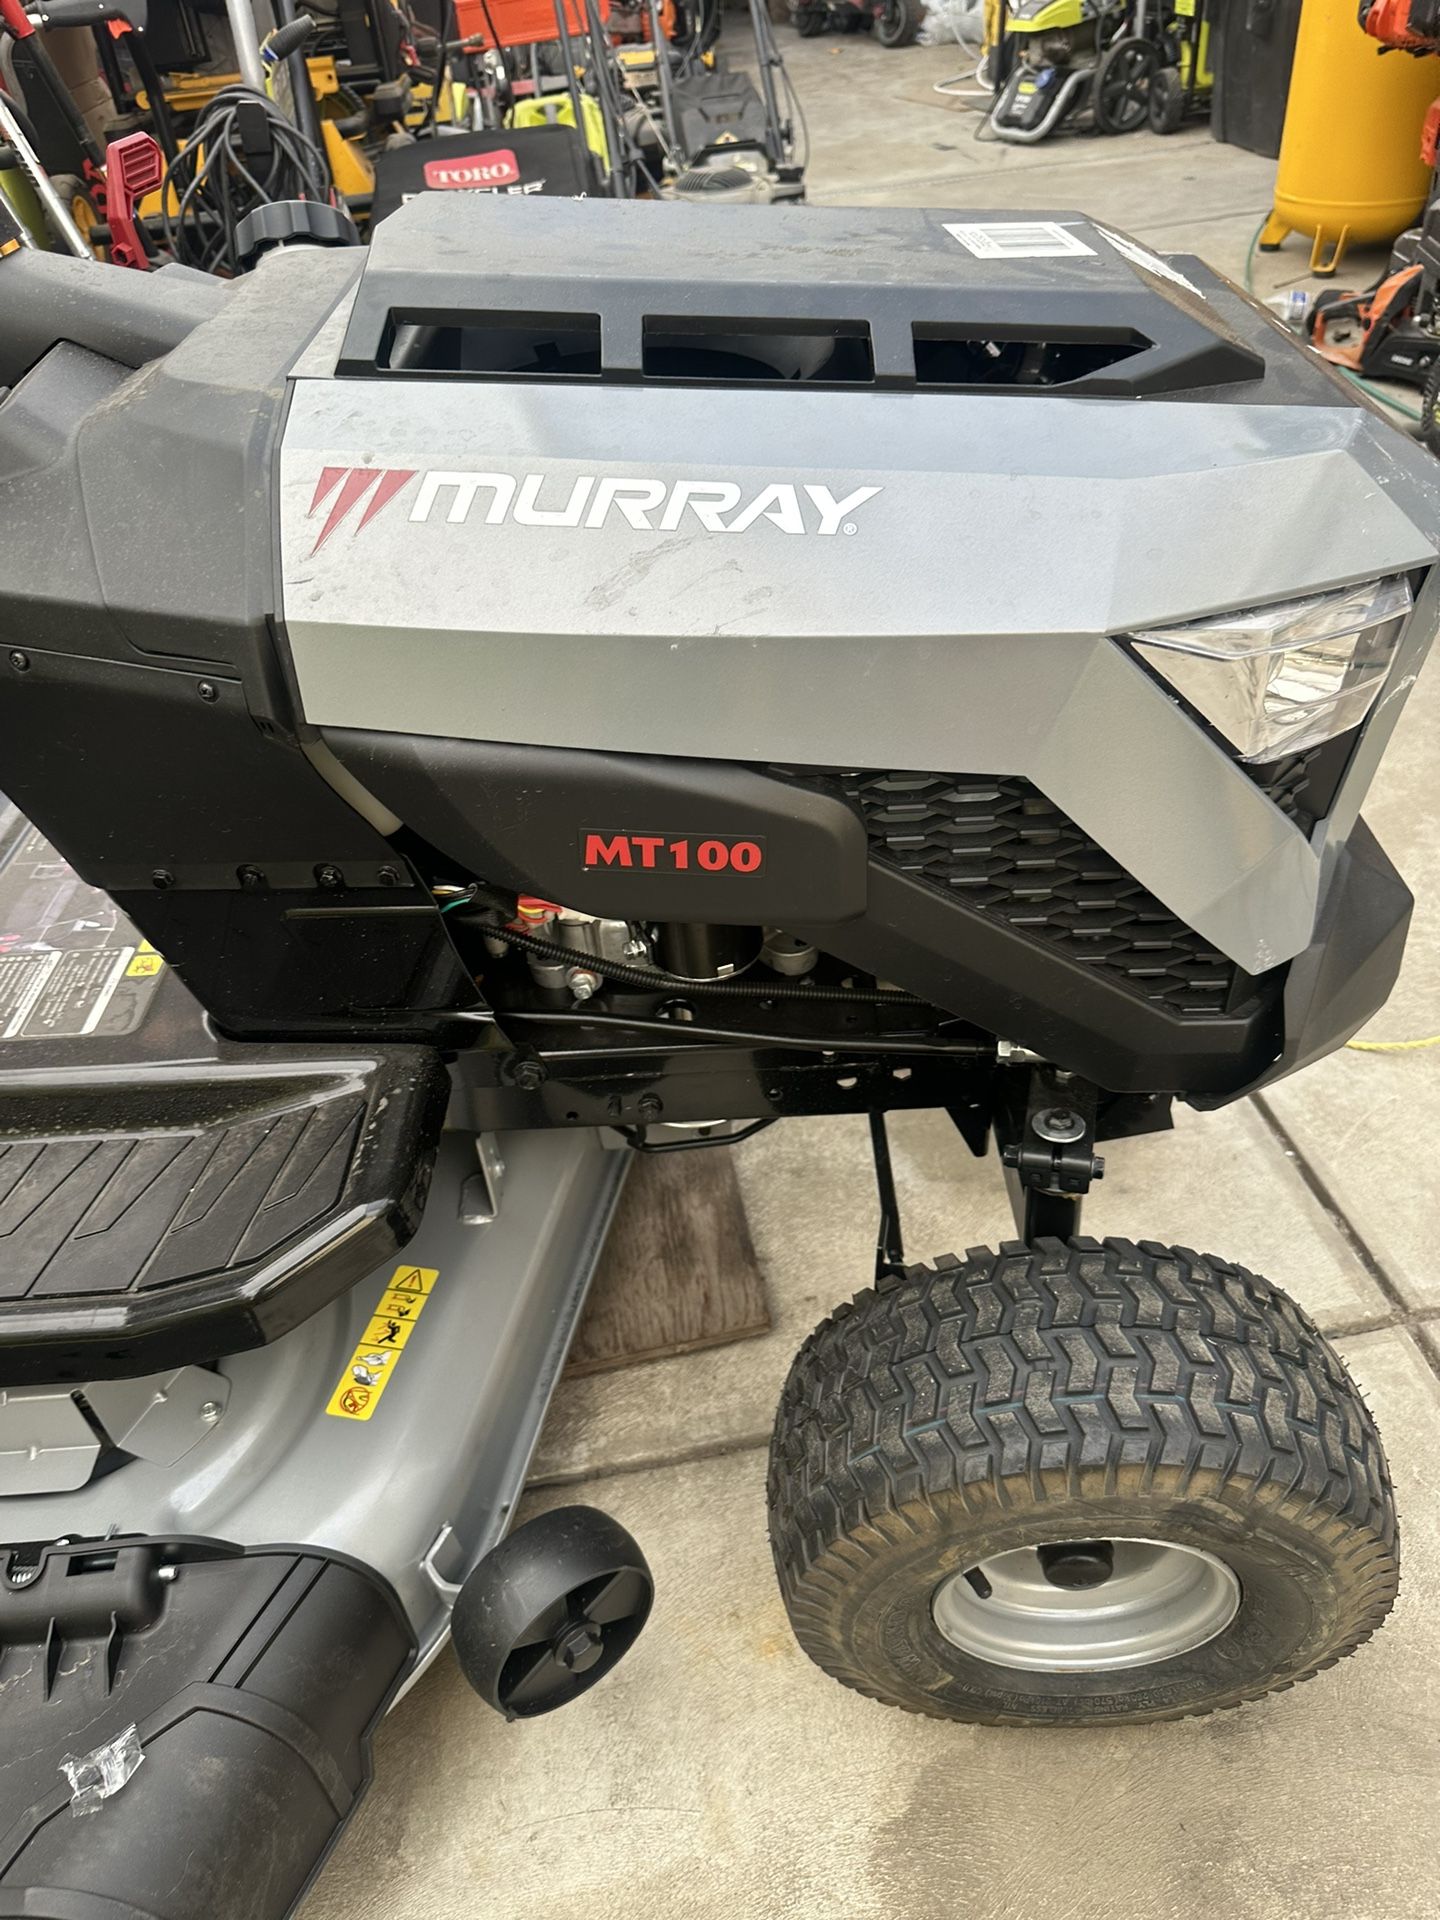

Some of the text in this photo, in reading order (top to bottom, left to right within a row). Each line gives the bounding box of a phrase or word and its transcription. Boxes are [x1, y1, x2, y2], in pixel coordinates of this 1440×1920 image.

[432, 163, 511, 184] TORO
[408, 470, 885, 536] MURRAY
[585, 834, 762, 873] MT100
[1136, 1699, 1156, 1709] PLY
